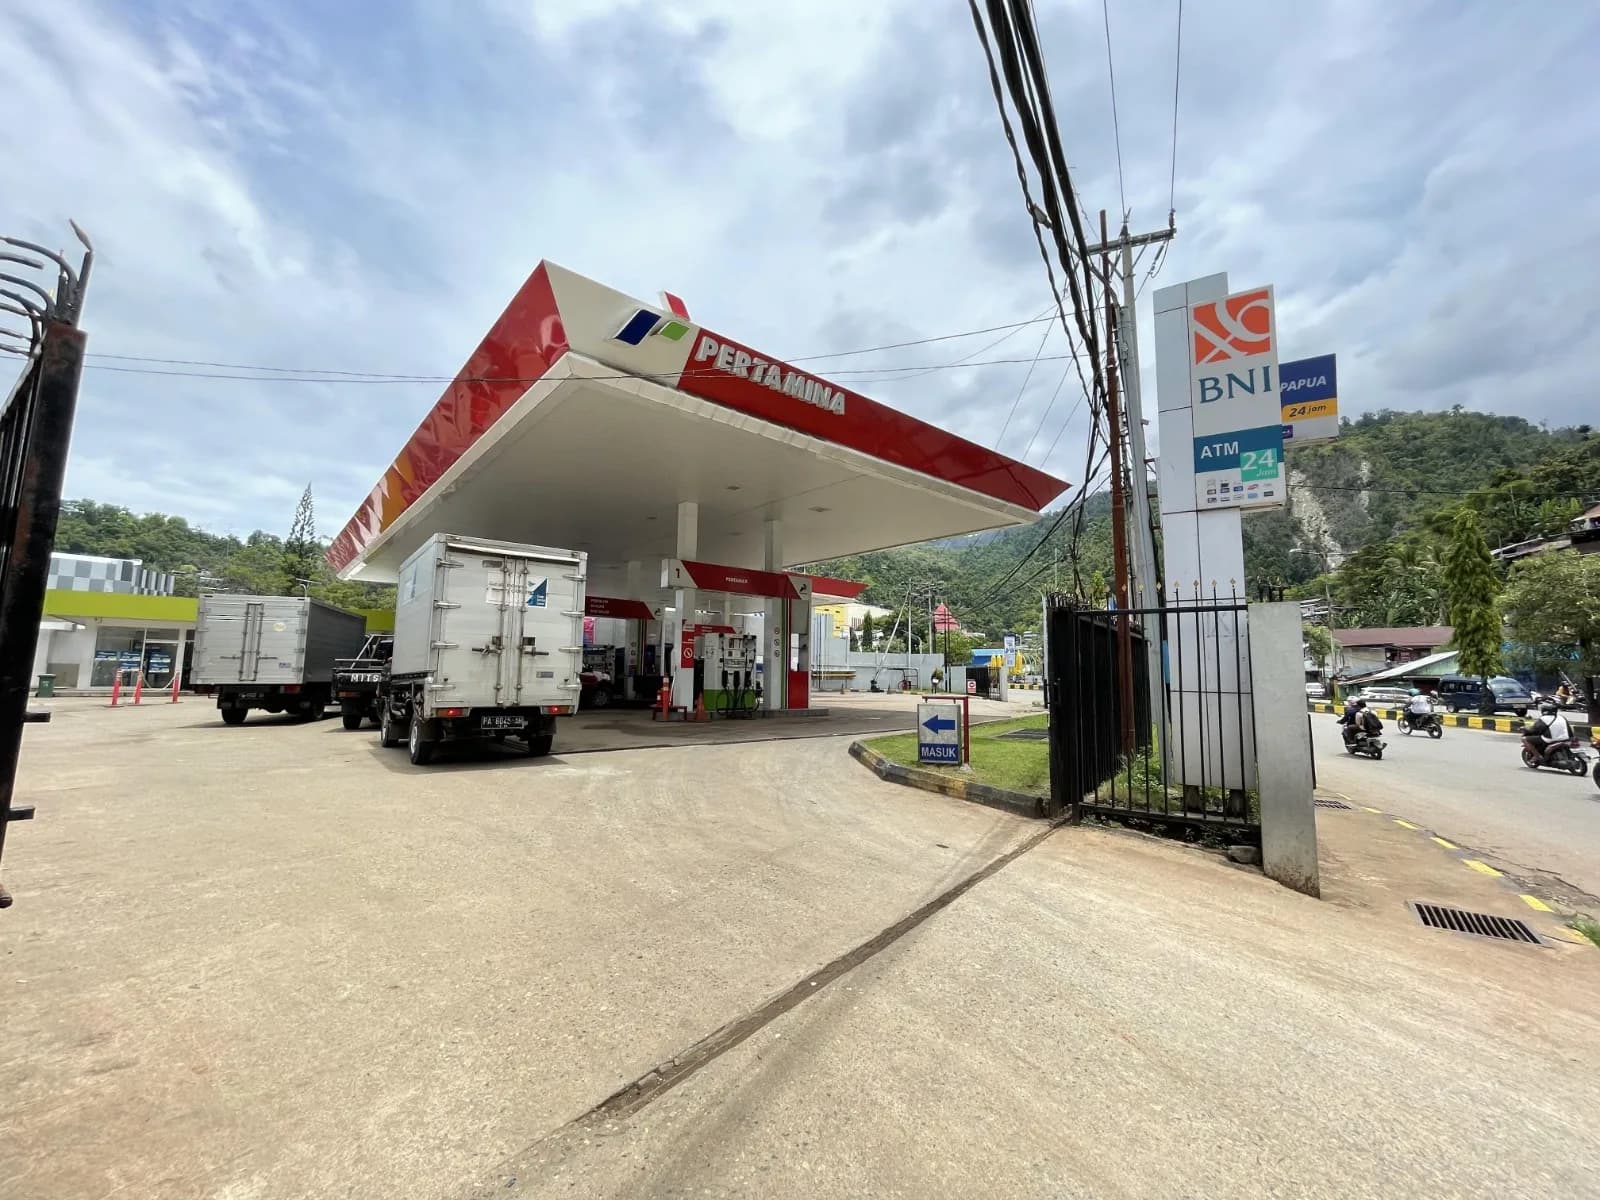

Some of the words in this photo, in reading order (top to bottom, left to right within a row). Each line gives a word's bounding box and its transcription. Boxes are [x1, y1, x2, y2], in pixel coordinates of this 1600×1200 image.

[694, 336, 845, 415] PERTAMINA
[1280, 376, 1327, 392] PAPUA
[1198, 366, 1272, 404] BNI
[1289, 406, 1306, 418] 24
[1308, 403, 1327, 415] jam
[1201, 441, 1239, 459] ATM
[1243, 449, 1275, 471] 24
[921, 746, 956, 758] MASUK
